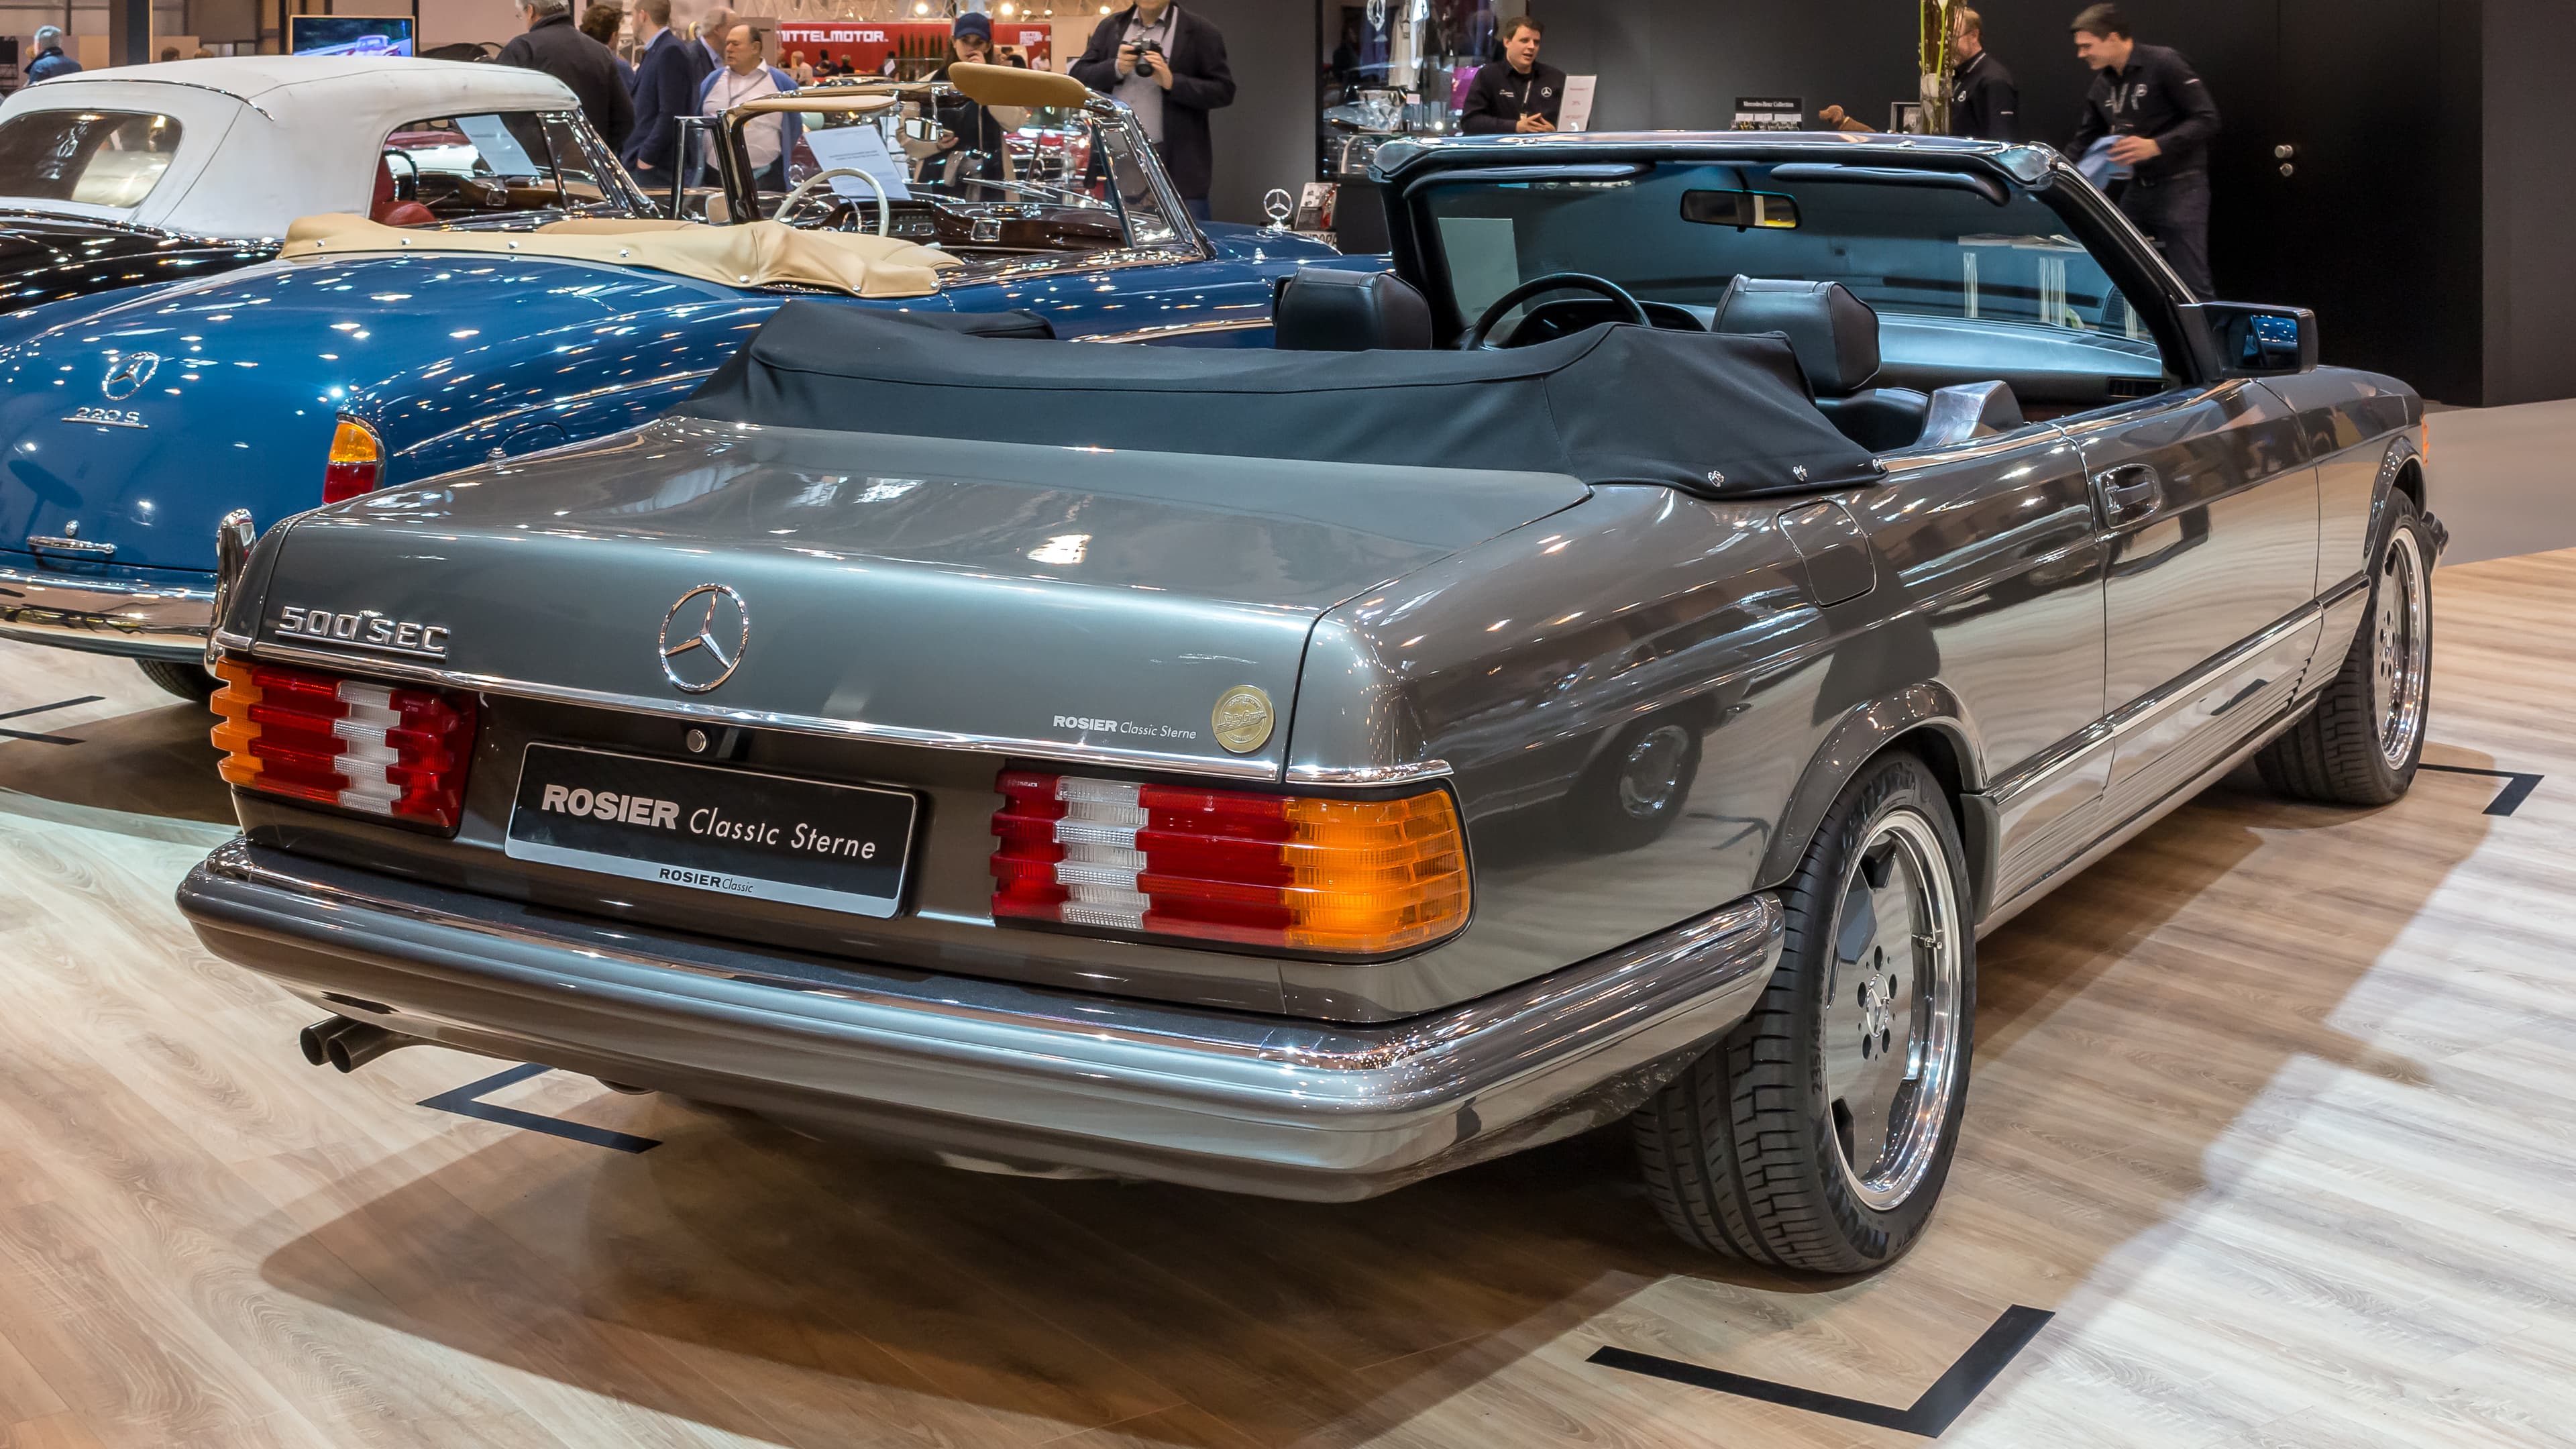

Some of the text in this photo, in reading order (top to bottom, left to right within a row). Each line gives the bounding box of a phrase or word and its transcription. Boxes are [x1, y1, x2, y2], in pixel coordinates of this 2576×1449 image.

[76, 407, 140, 423] 220 S
[278, 606, 451, 653] 500 SEC
[1053, 715, 1197, 739] ROSIER Classic Sterne
[541, 784, 876, 860] ROSIER Classic Sterne
[659, 868, 754, 893] ROSIER Classic
